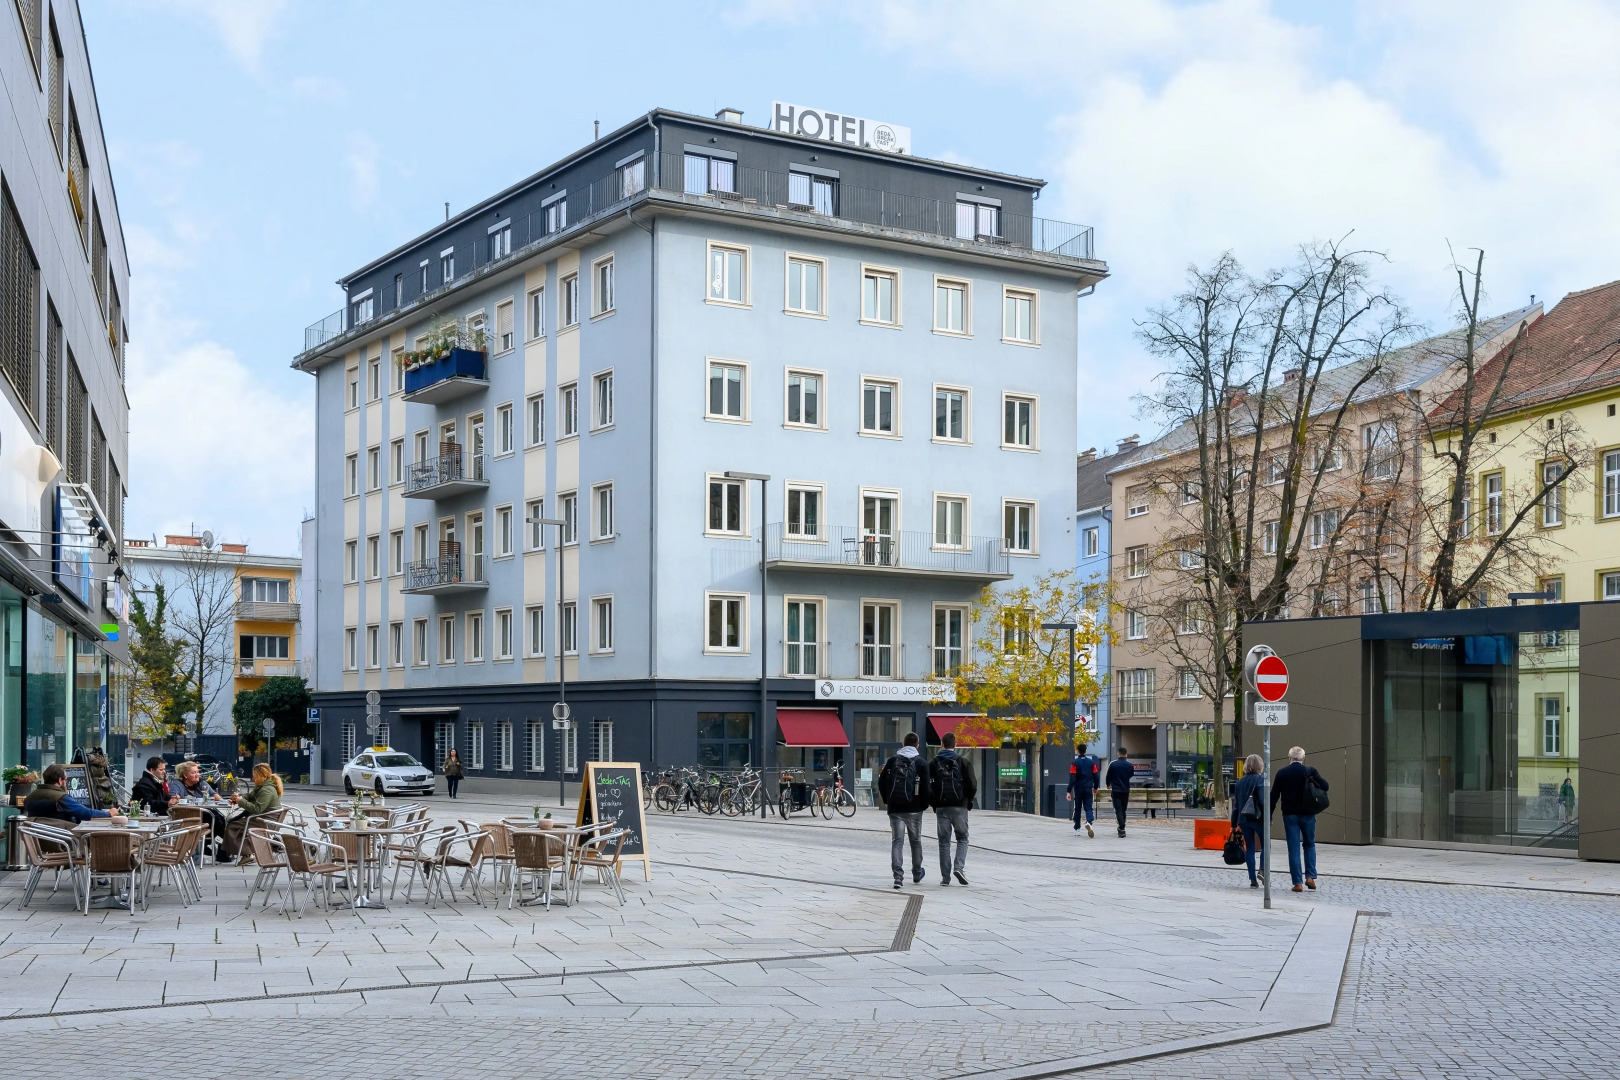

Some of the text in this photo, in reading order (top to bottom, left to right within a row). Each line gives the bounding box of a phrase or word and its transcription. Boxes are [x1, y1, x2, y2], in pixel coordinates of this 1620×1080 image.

[775, 103, 865, 147] HOTEL
[839, 684, 899, 695] FOTOSTUDIO
[311, 709, 318, 718] P
